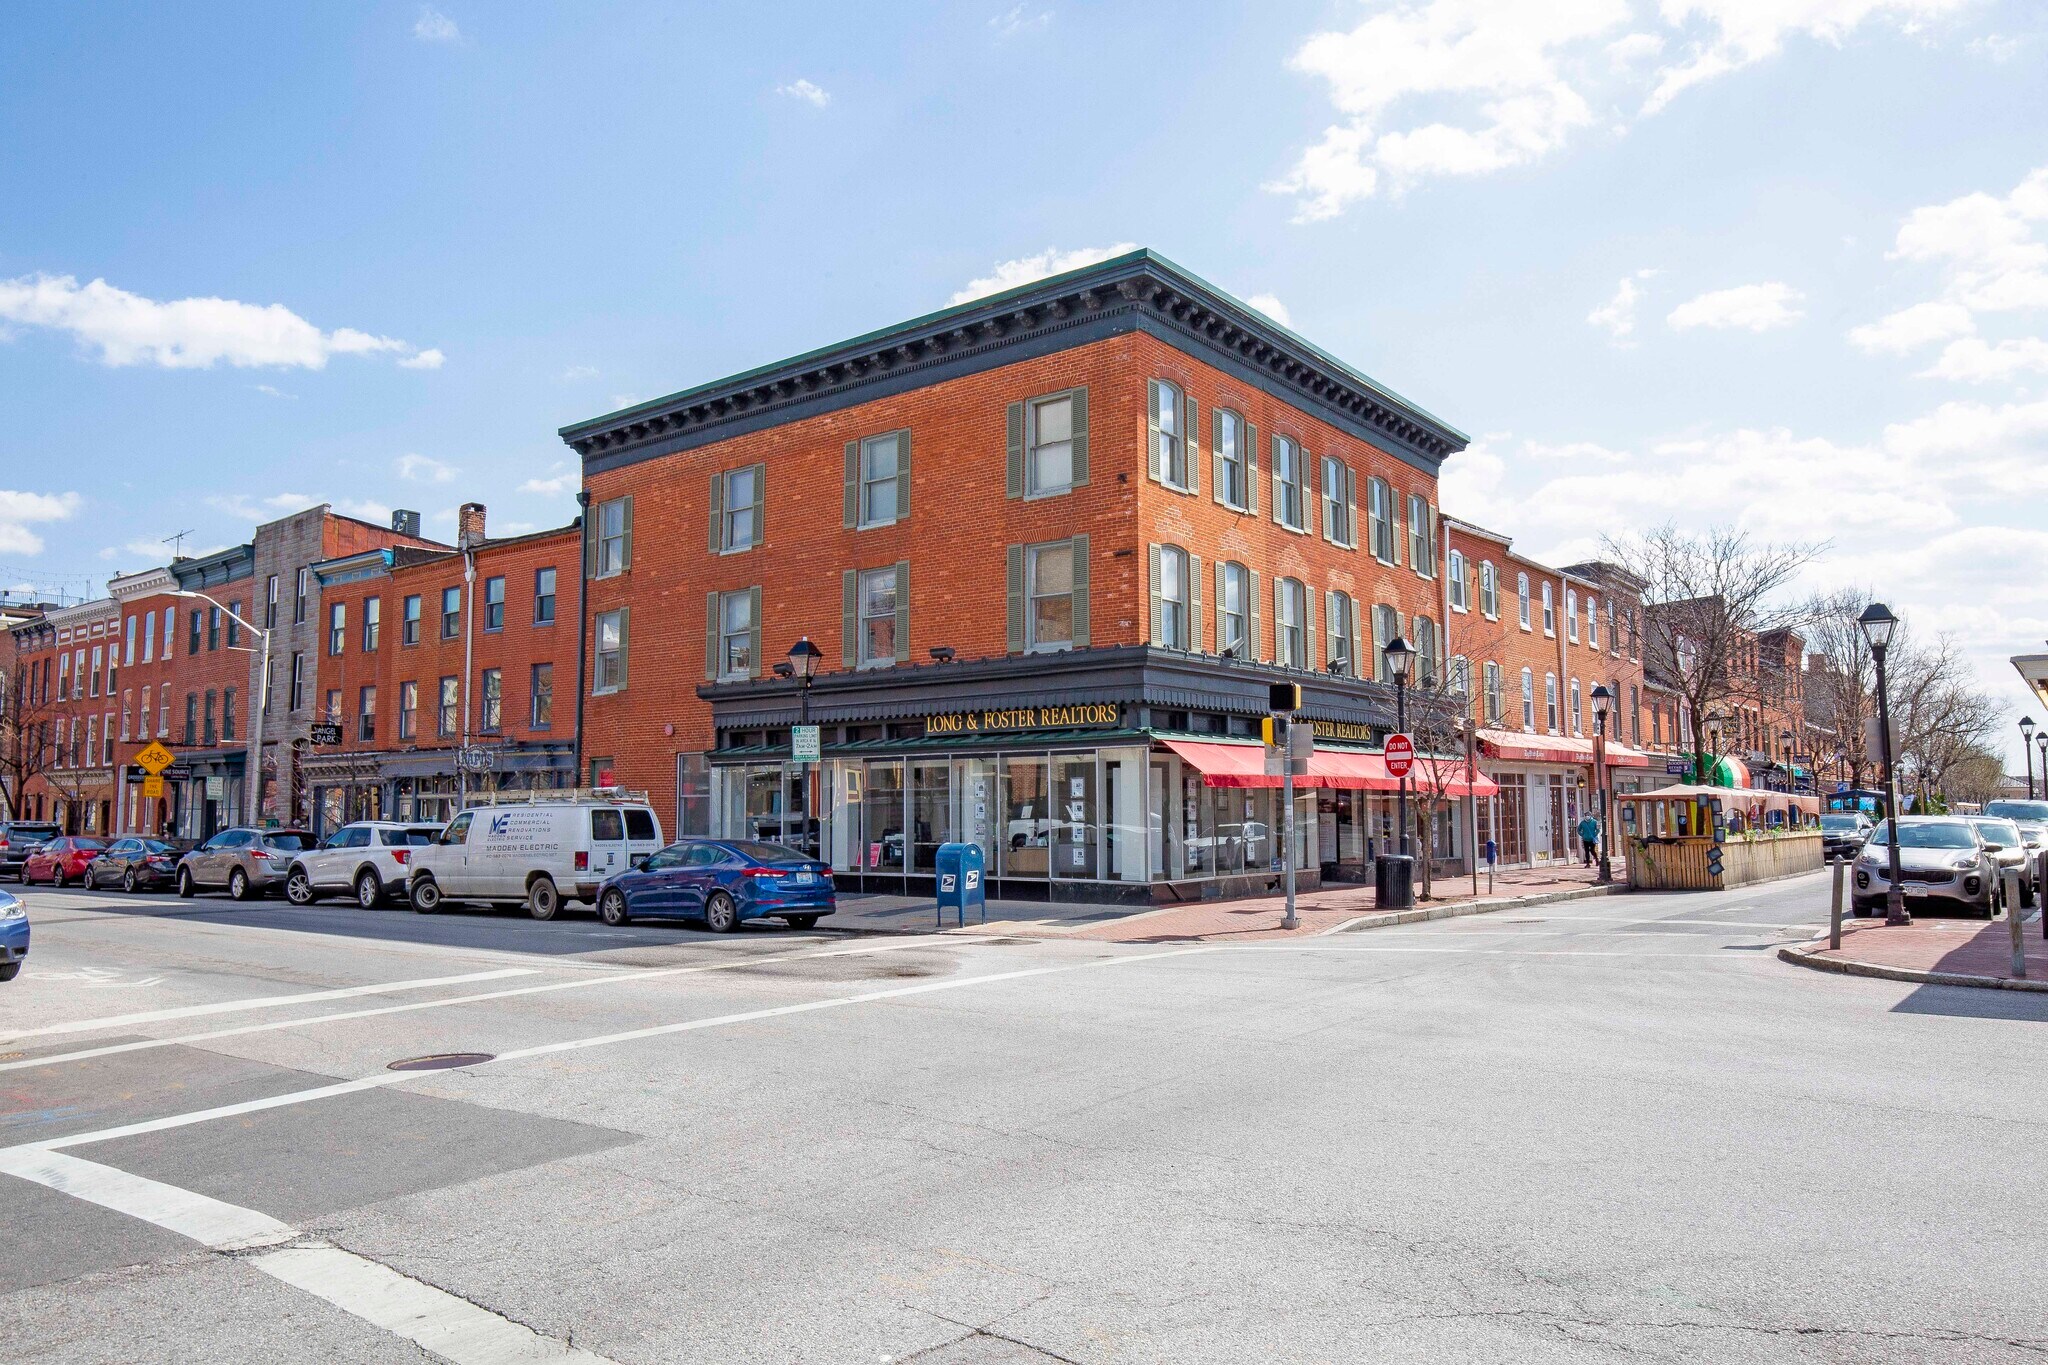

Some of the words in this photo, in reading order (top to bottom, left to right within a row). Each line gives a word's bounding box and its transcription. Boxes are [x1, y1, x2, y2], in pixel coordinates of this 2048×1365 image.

[927, 714, 963, 733] LONG
[966, 713, 978, 730] &
[984, 709, 1036, 730] FOSTER
[1041, 704, 1117, 726] REALTORS
[1308, 720, 1335, 737] OSTER
[1336, 722, 1371, 740] REALTORS
[317, 735, 336, 743] PARK
[1389, 742, 1397, 750] DO
[1397, 742, 1408, 750] NOT
[1391, 762, 1407, 770] ENTER
